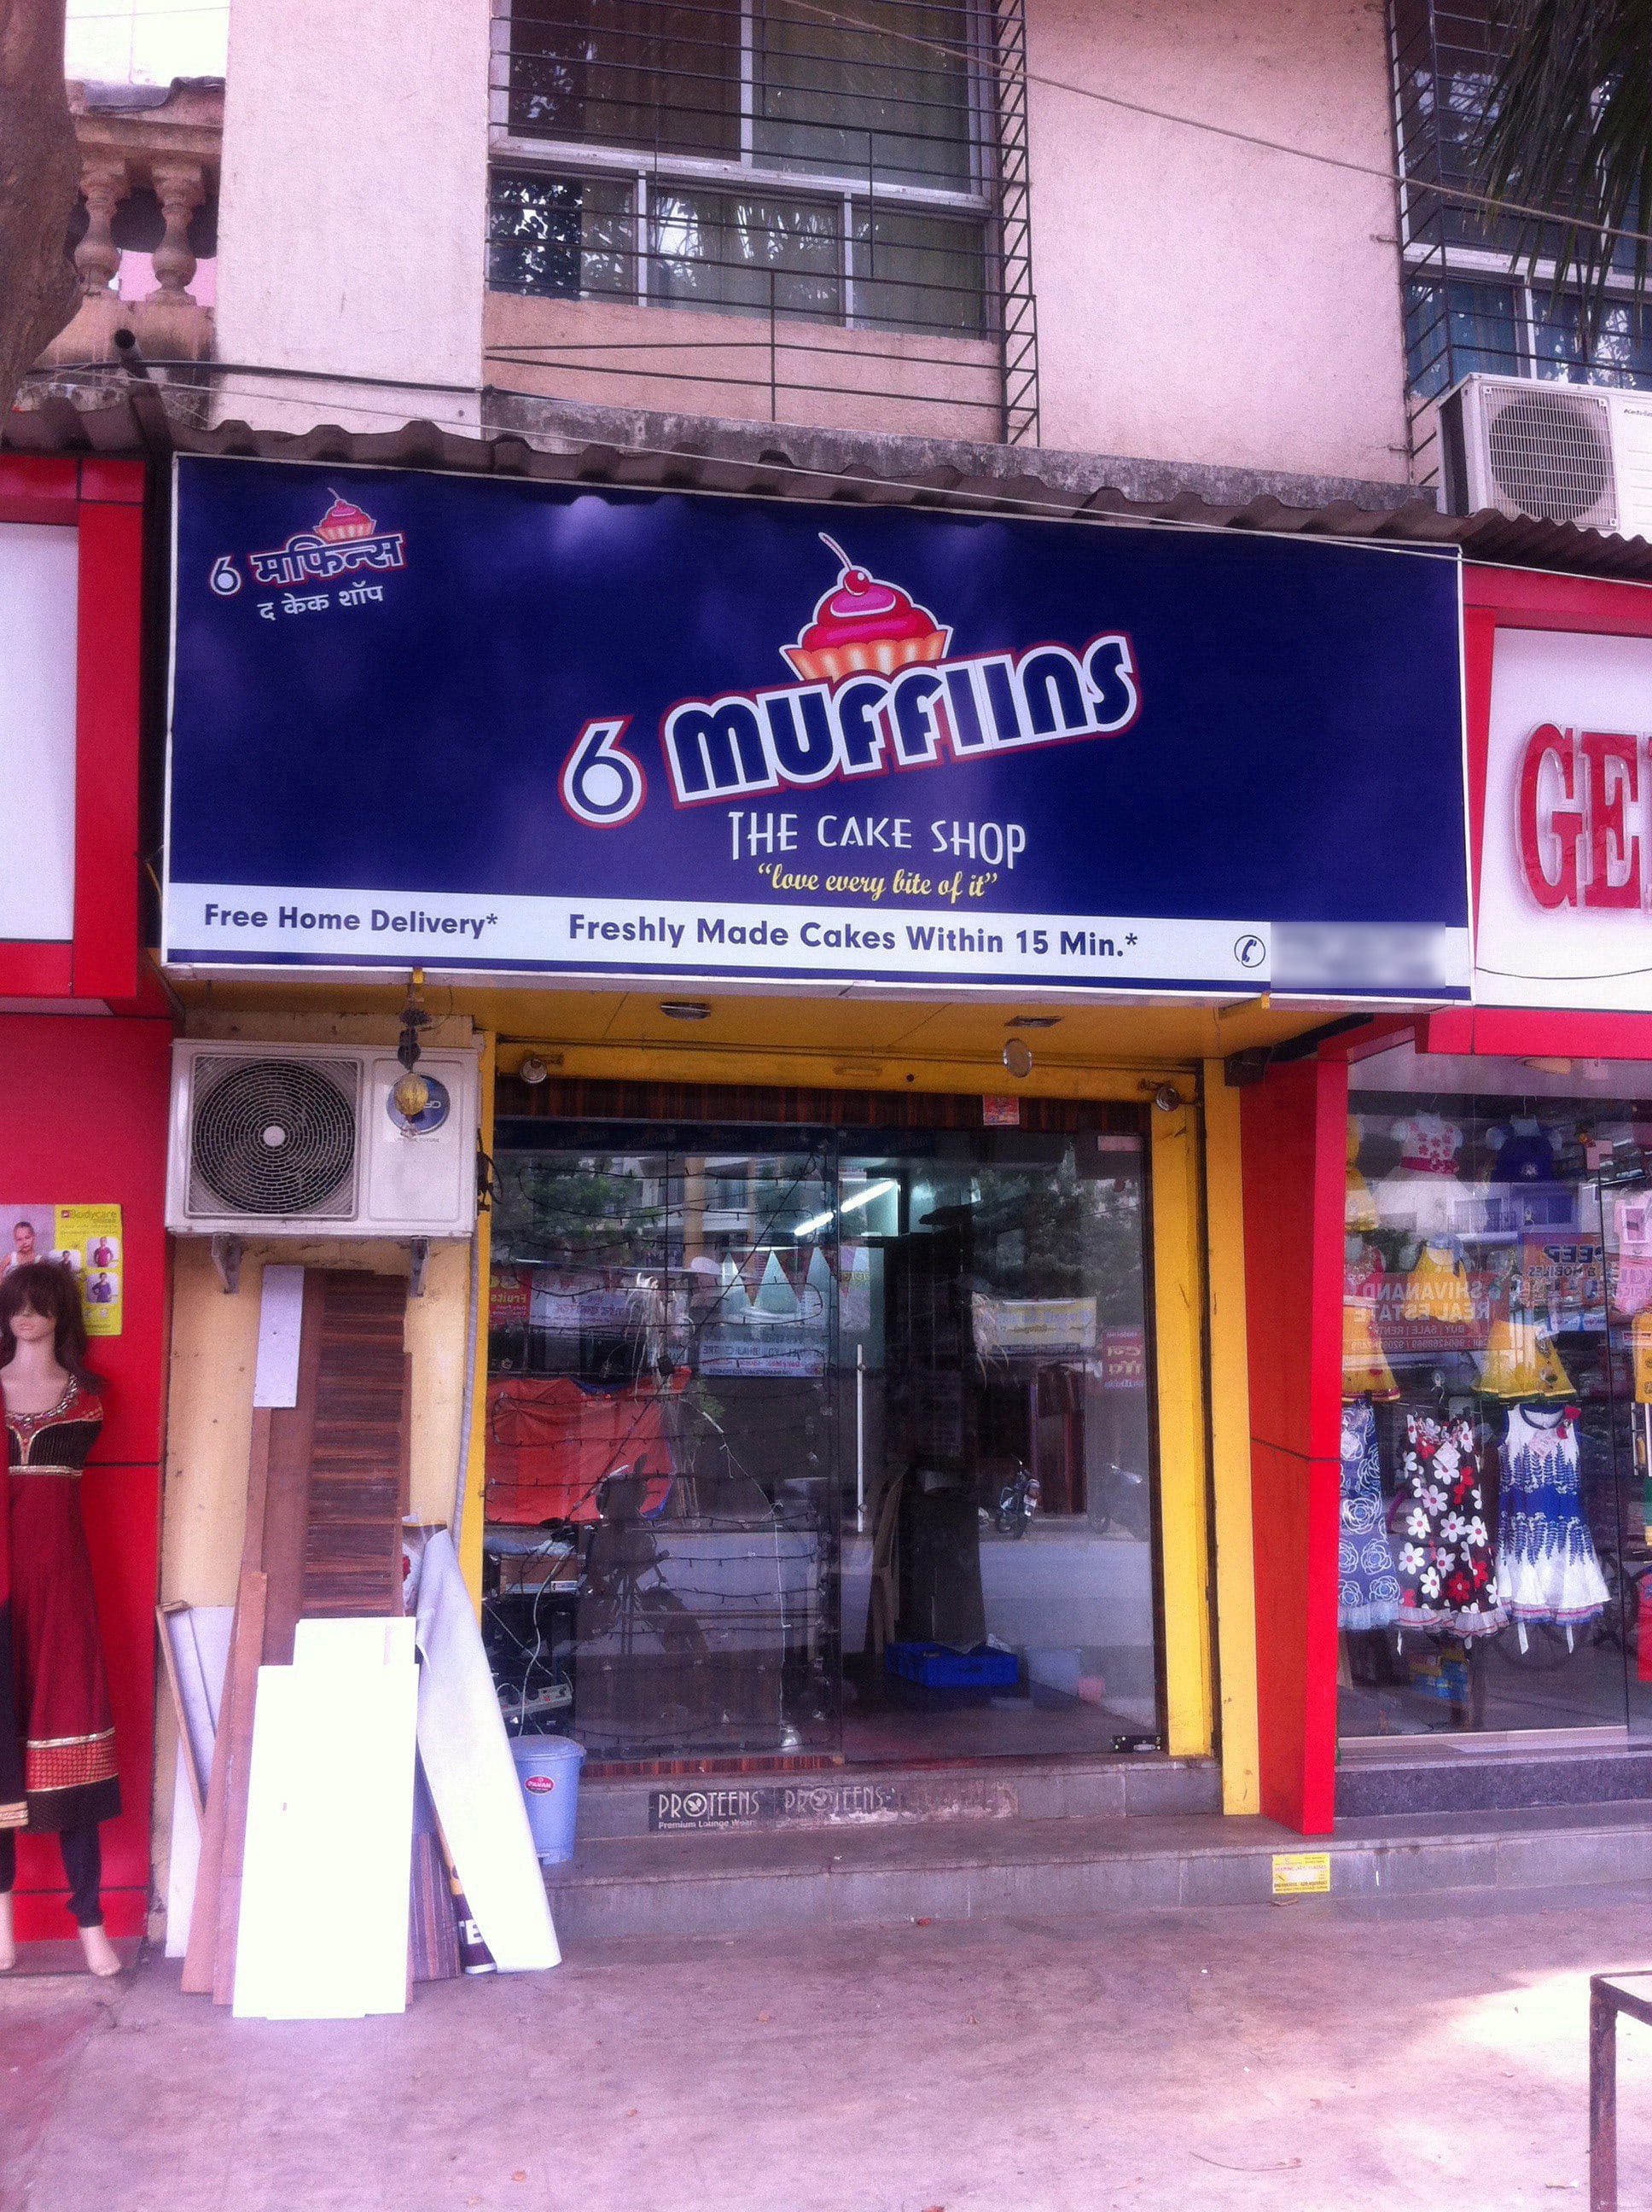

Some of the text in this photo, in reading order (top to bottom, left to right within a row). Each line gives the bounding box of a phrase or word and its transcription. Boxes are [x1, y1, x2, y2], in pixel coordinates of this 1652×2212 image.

[210, 556, 242, 597] 6
[257, 580, 384, 621] द केक शॉप
[561, 718, 645, 826] 6
[1519, 722, 1652, 910] GE
[728, 811, 1026, 870] THE CAKE SHOP
[825, 872, 887, 901] every
[892, 868, 933, 895] bite
[937, 870, 963, 905] of
[204, 903, 269, 928] Free
[277, 905, 361, 931] Home
[569, 913, 685, 948] Freshly
[696, 917, 789, 946] Made
[799, 921, 896, 950] Cakes
[905, 924, 1003, 953] Within
[1015, 929, 1050, 955] 15
[658, 1790, 759, 1819] PROTEENS
[658, 1820, 696, 1830] Premium
[698, 1819, 730, 1830] Lounge
